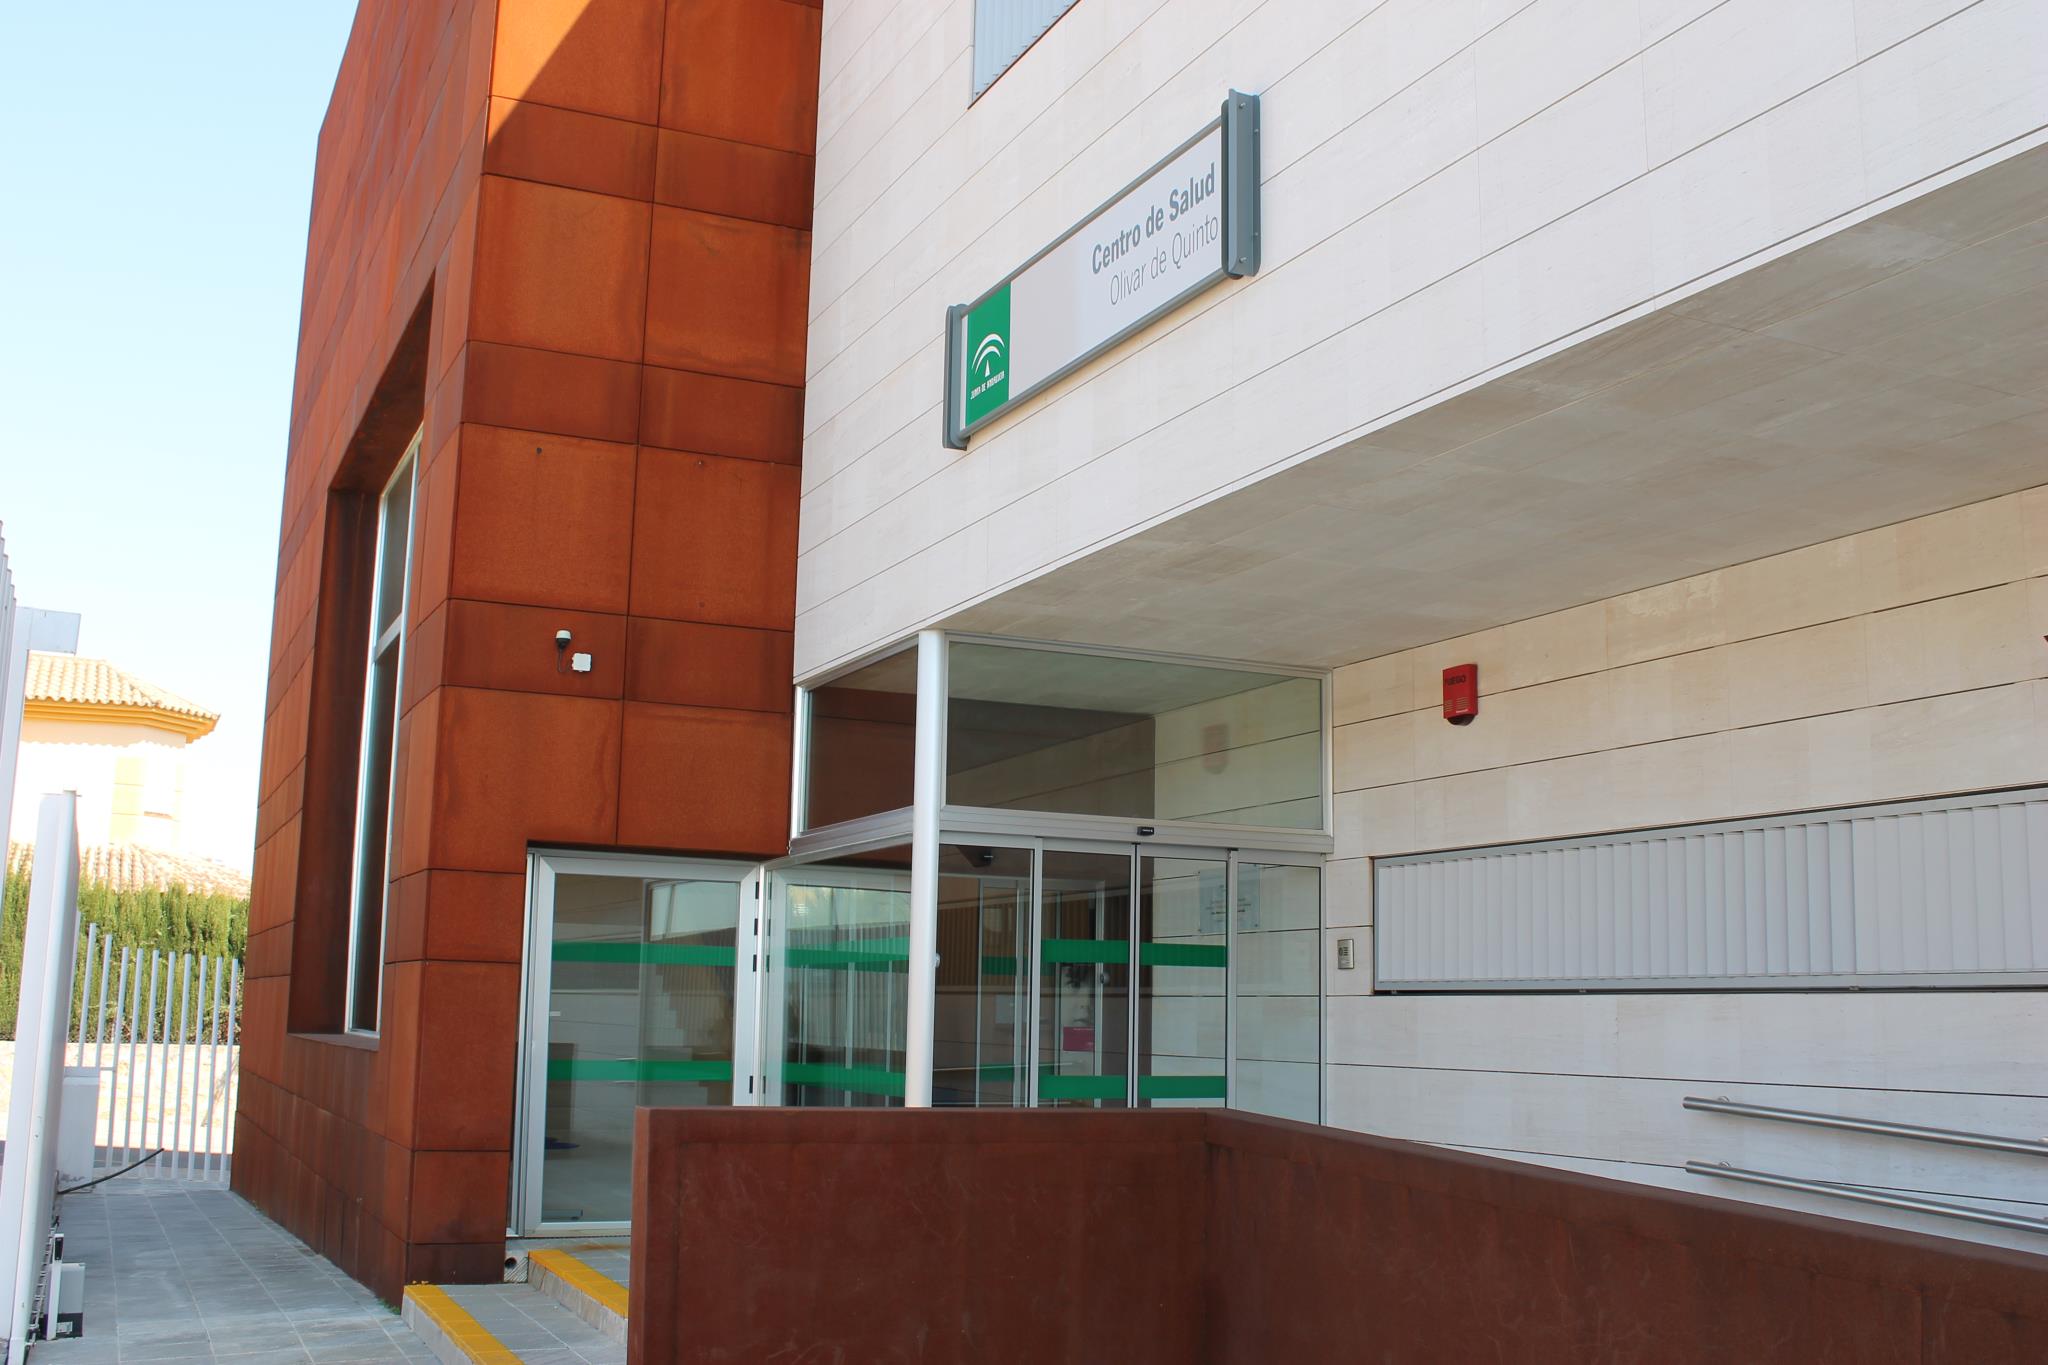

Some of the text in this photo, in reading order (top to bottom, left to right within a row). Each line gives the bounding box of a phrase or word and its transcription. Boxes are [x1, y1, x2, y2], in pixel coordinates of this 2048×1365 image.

[1092, 162, 1215, 274] Centro de Salud
[1110, 214, 1219, 305] Olivar de Quinto
